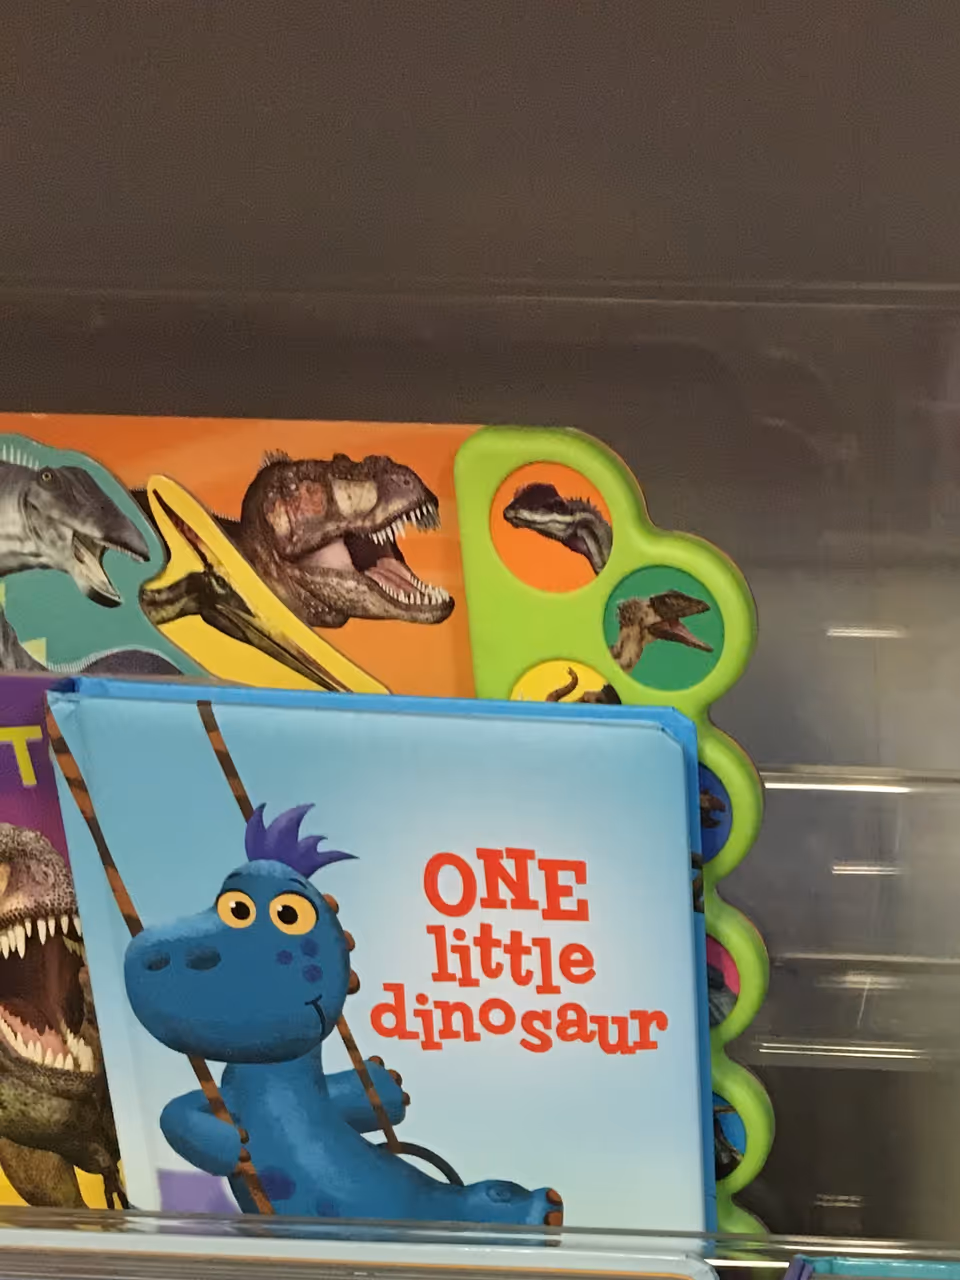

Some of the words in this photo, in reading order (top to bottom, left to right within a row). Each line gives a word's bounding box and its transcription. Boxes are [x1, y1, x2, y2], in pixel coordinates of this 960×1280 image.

[423, 847, 590, 922] ONE
[426, 922, 597, 994] little
[369, 983, 669, 1055] dinosaur
